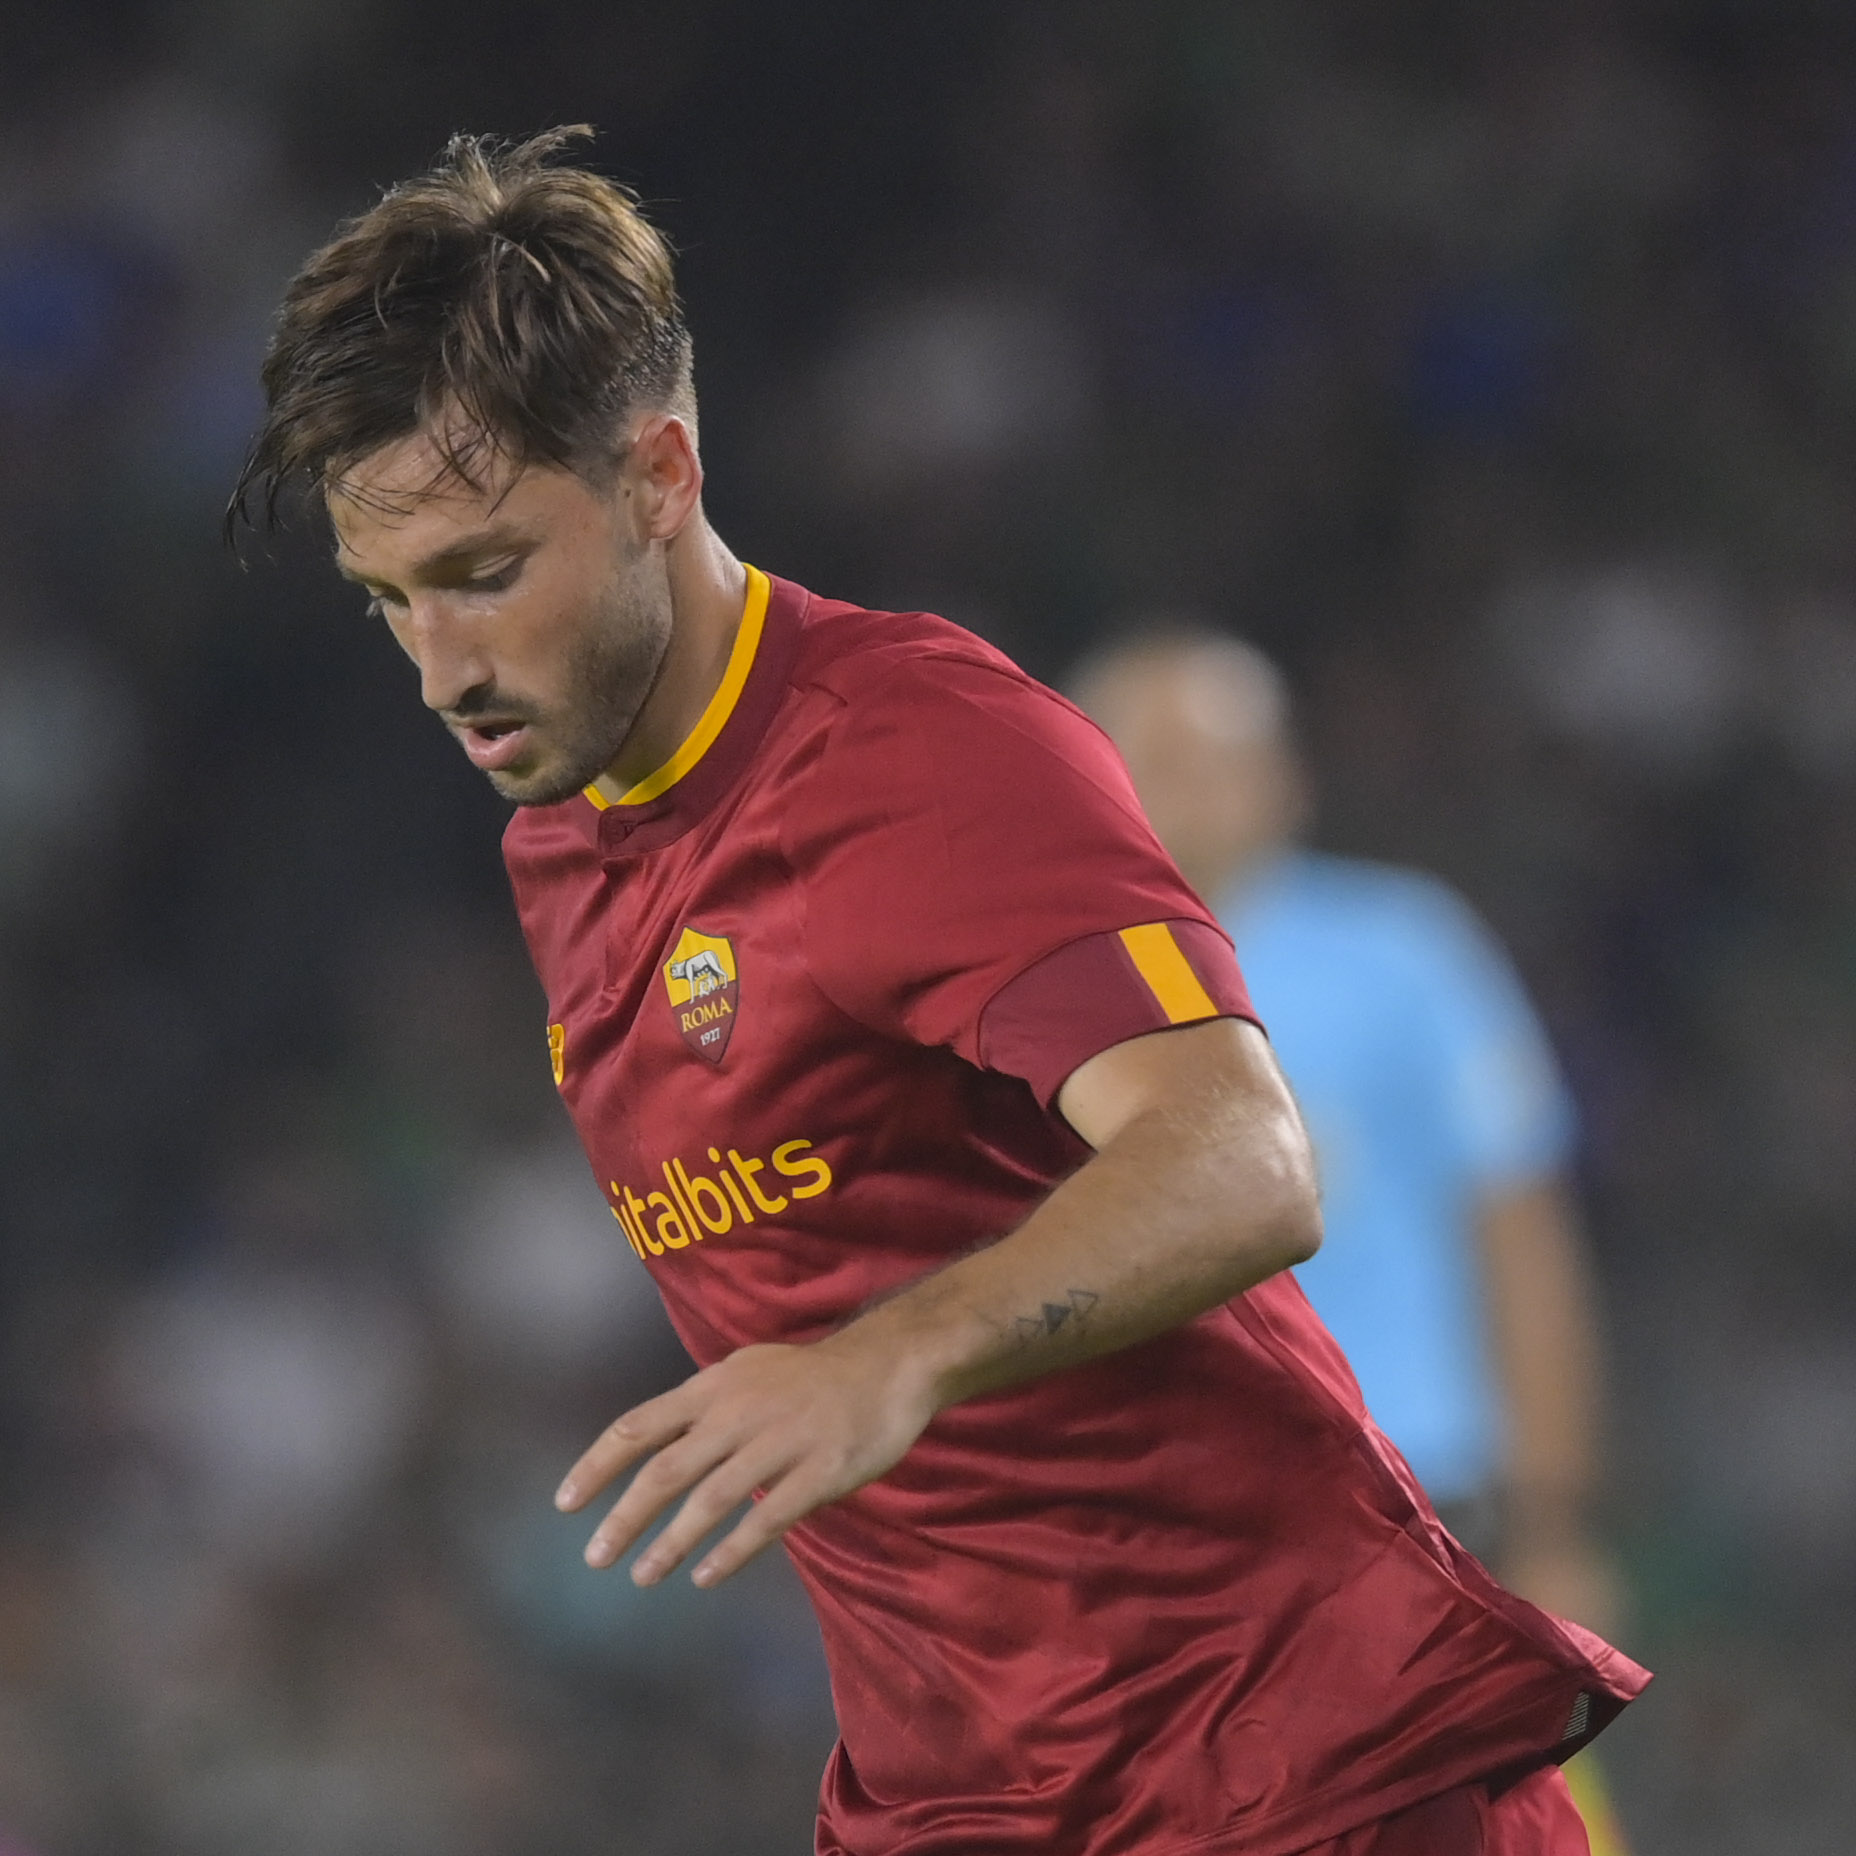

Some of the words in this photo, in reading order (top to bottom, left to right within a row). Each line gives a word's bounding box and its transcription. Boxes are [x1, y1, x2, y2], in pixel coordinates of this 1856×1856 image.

[681, 996, 733, 1033] ROMA
[700, 1026, 721, 1046] 1927
[610, 1139, 832, 1260] italbits
